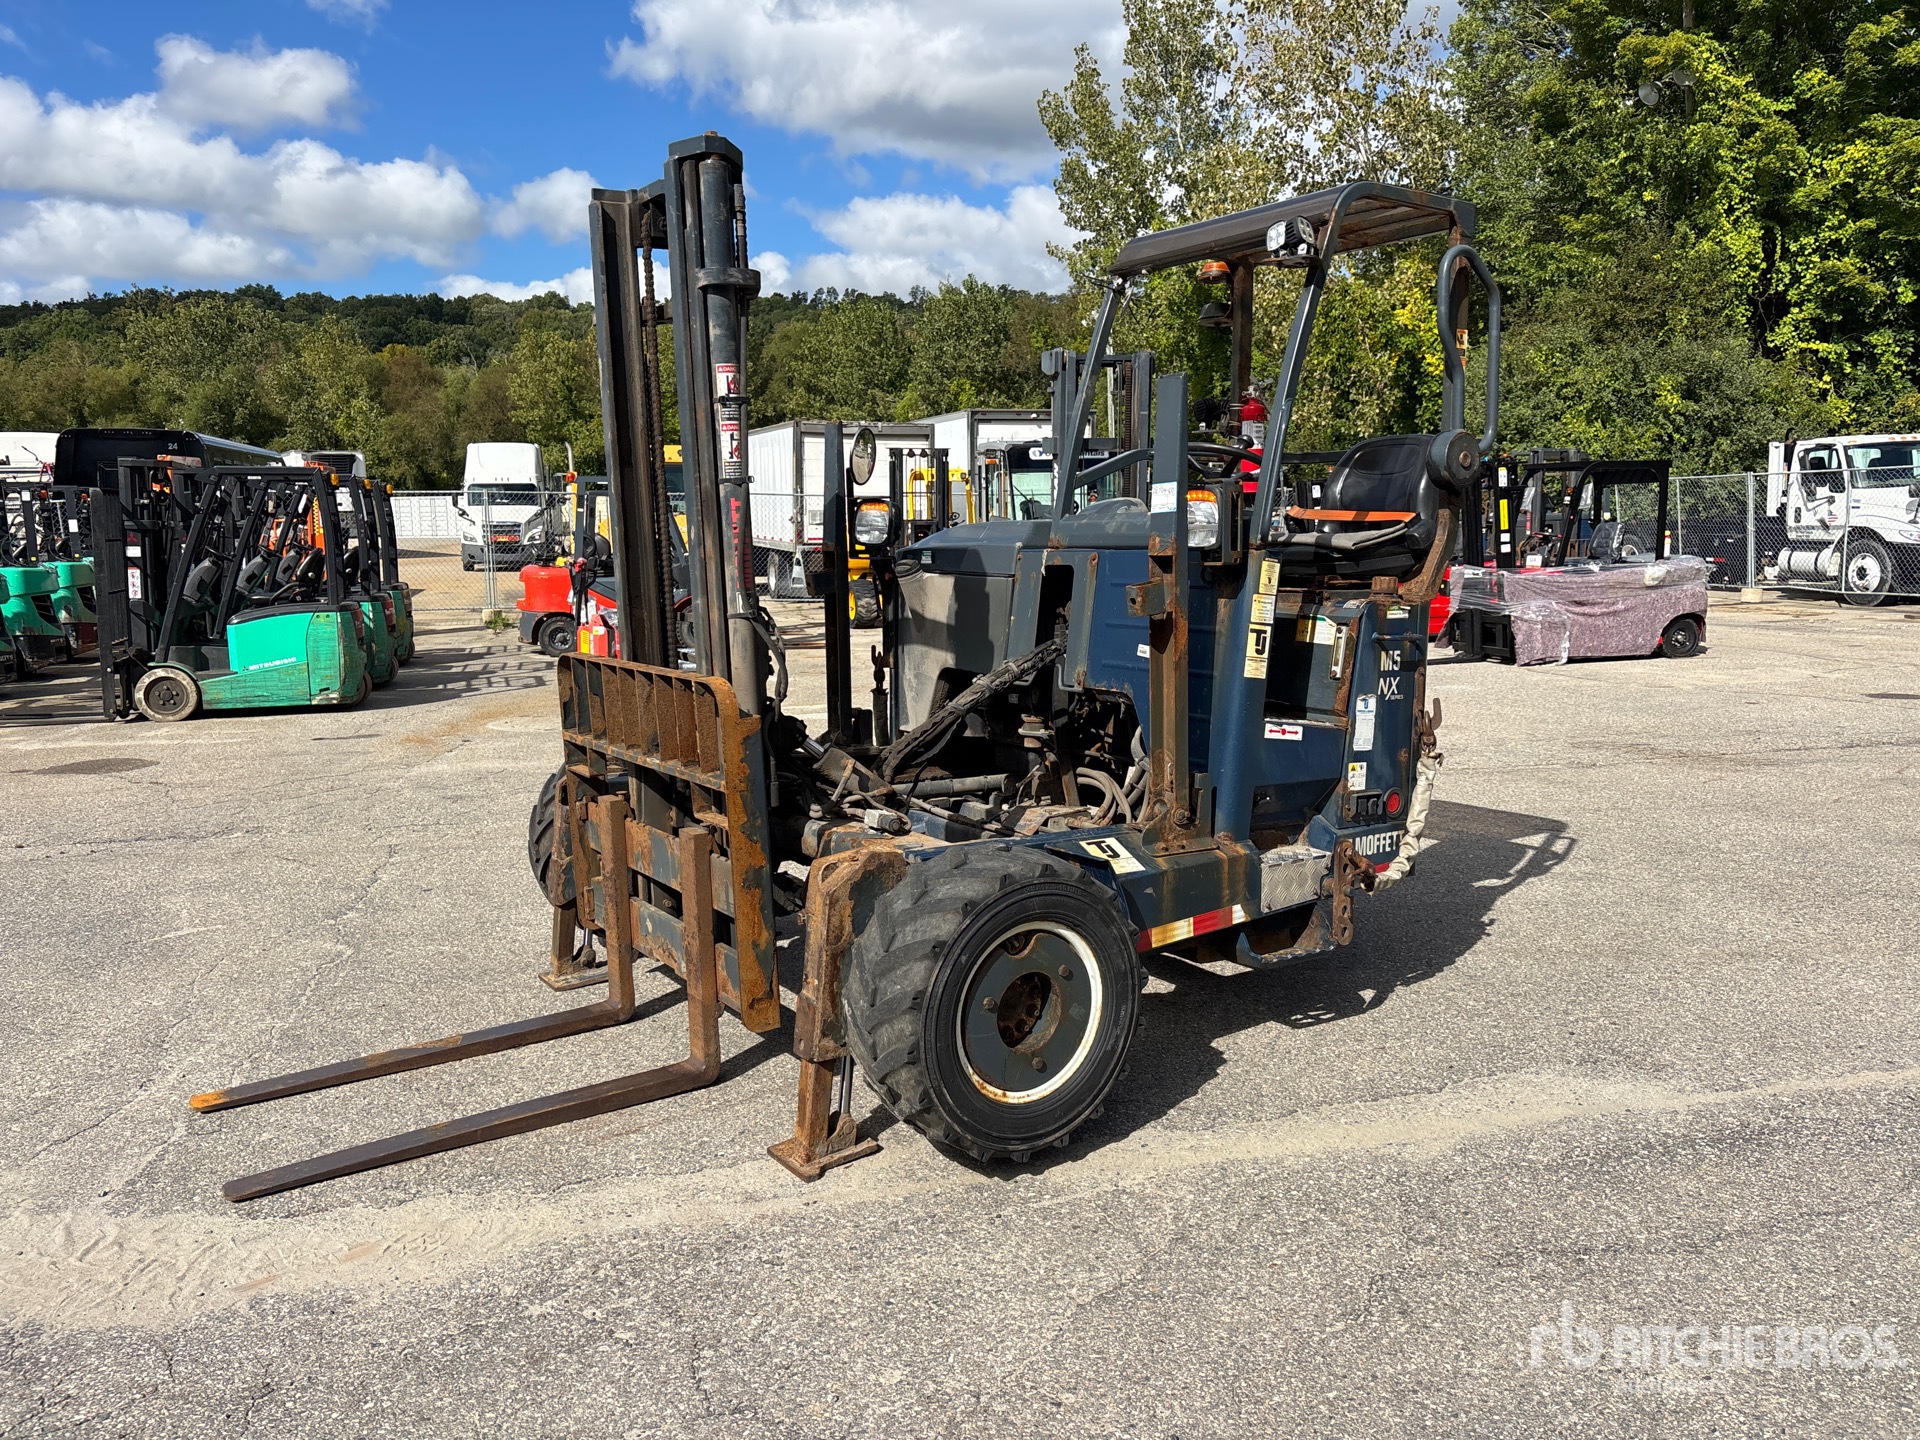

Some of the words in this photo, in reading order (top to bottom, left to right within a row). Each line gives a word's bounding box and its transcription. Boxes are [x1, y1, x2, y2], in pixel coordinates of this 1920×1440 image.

[1249, 628, 1267, 656] TJ
[1380, 650, 1401, 672] M5
[1377, 676, 1400, 700] NX
[1085, 839, 1121, 859] TJ
